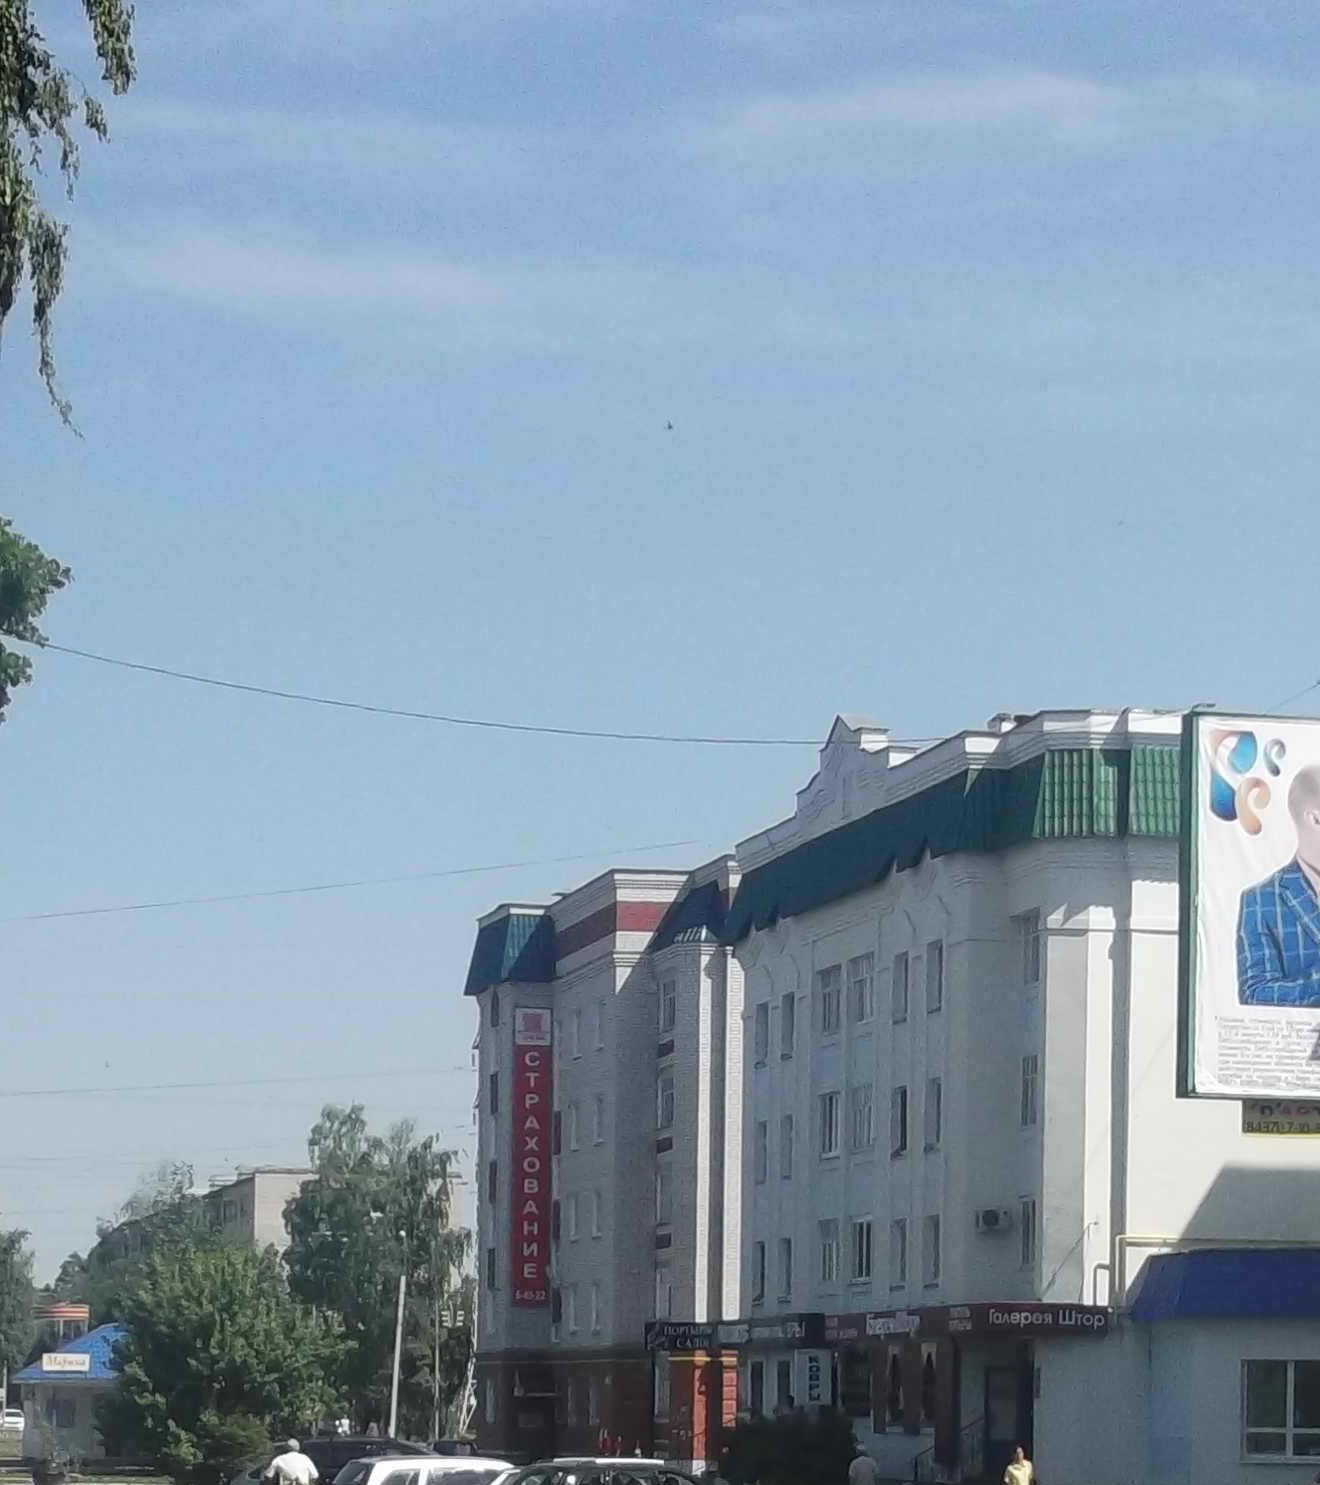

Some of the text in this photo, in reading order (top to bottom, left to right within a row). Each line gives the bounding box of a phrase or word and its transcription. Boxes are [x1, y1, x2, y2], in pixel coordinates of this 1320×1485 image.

[523, 1051, 541, 1279] СТРАХОВАНИЕ
[989, 1309, 1052, 1328] Галерея
[1059, 1309, 1105, 1330] Штор
